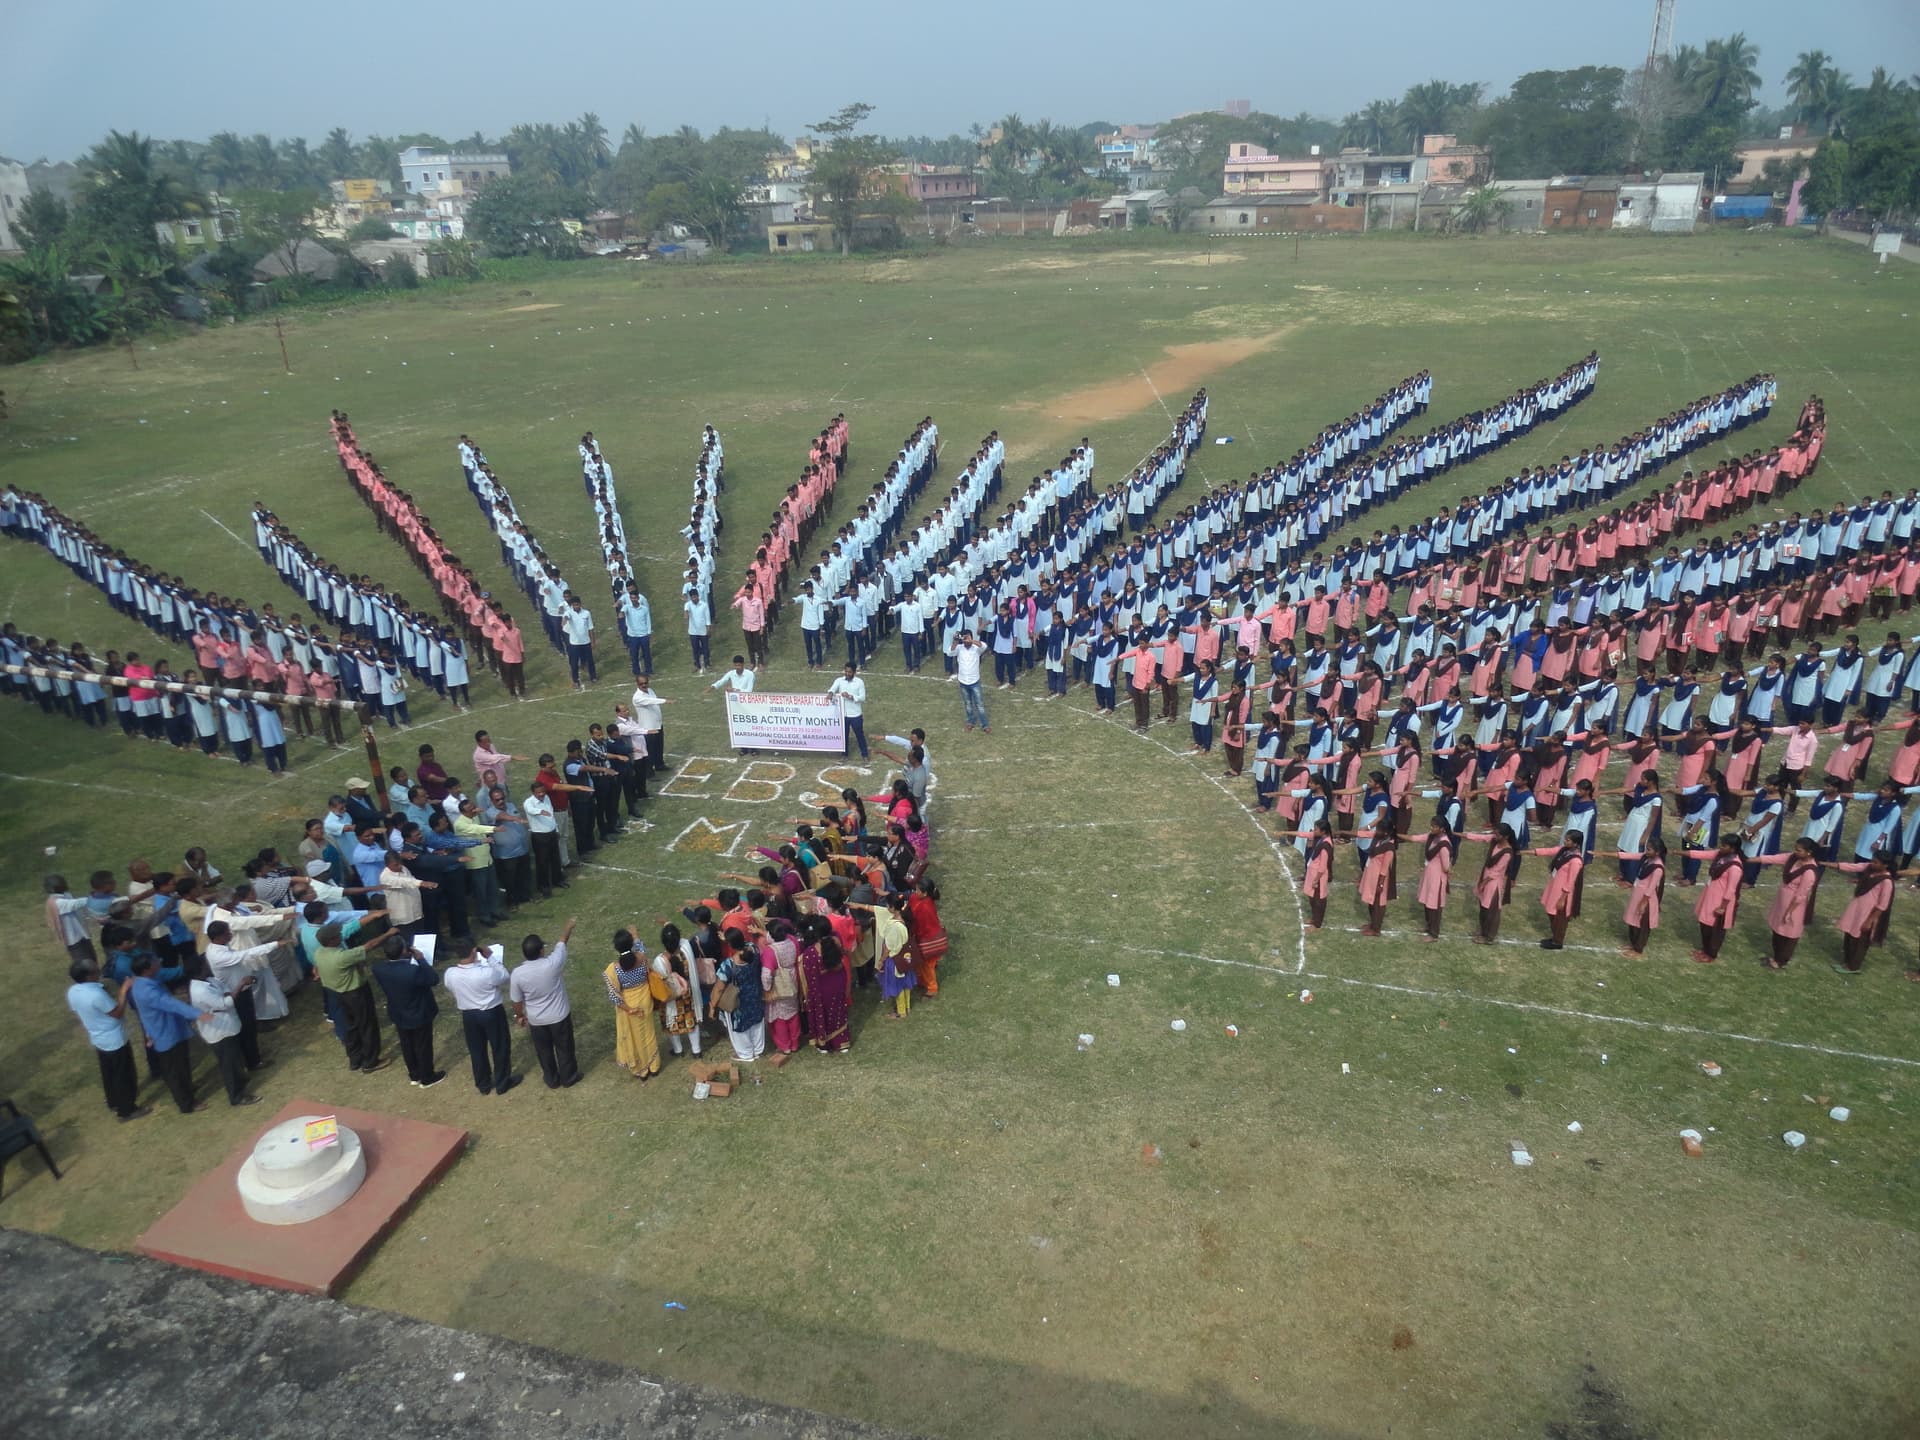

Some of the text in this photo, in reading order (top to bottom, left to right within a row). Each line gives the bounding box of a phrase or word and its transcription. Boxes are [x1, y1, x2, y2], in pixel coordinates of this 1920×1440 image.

[739, 693, 747, 703] EK
[748, 694, 768, 704] BHARAT
[794, 696, 814, 706] BHARAT
[733, 714, 840, 727] EBSB ACTIVITY MONTH
